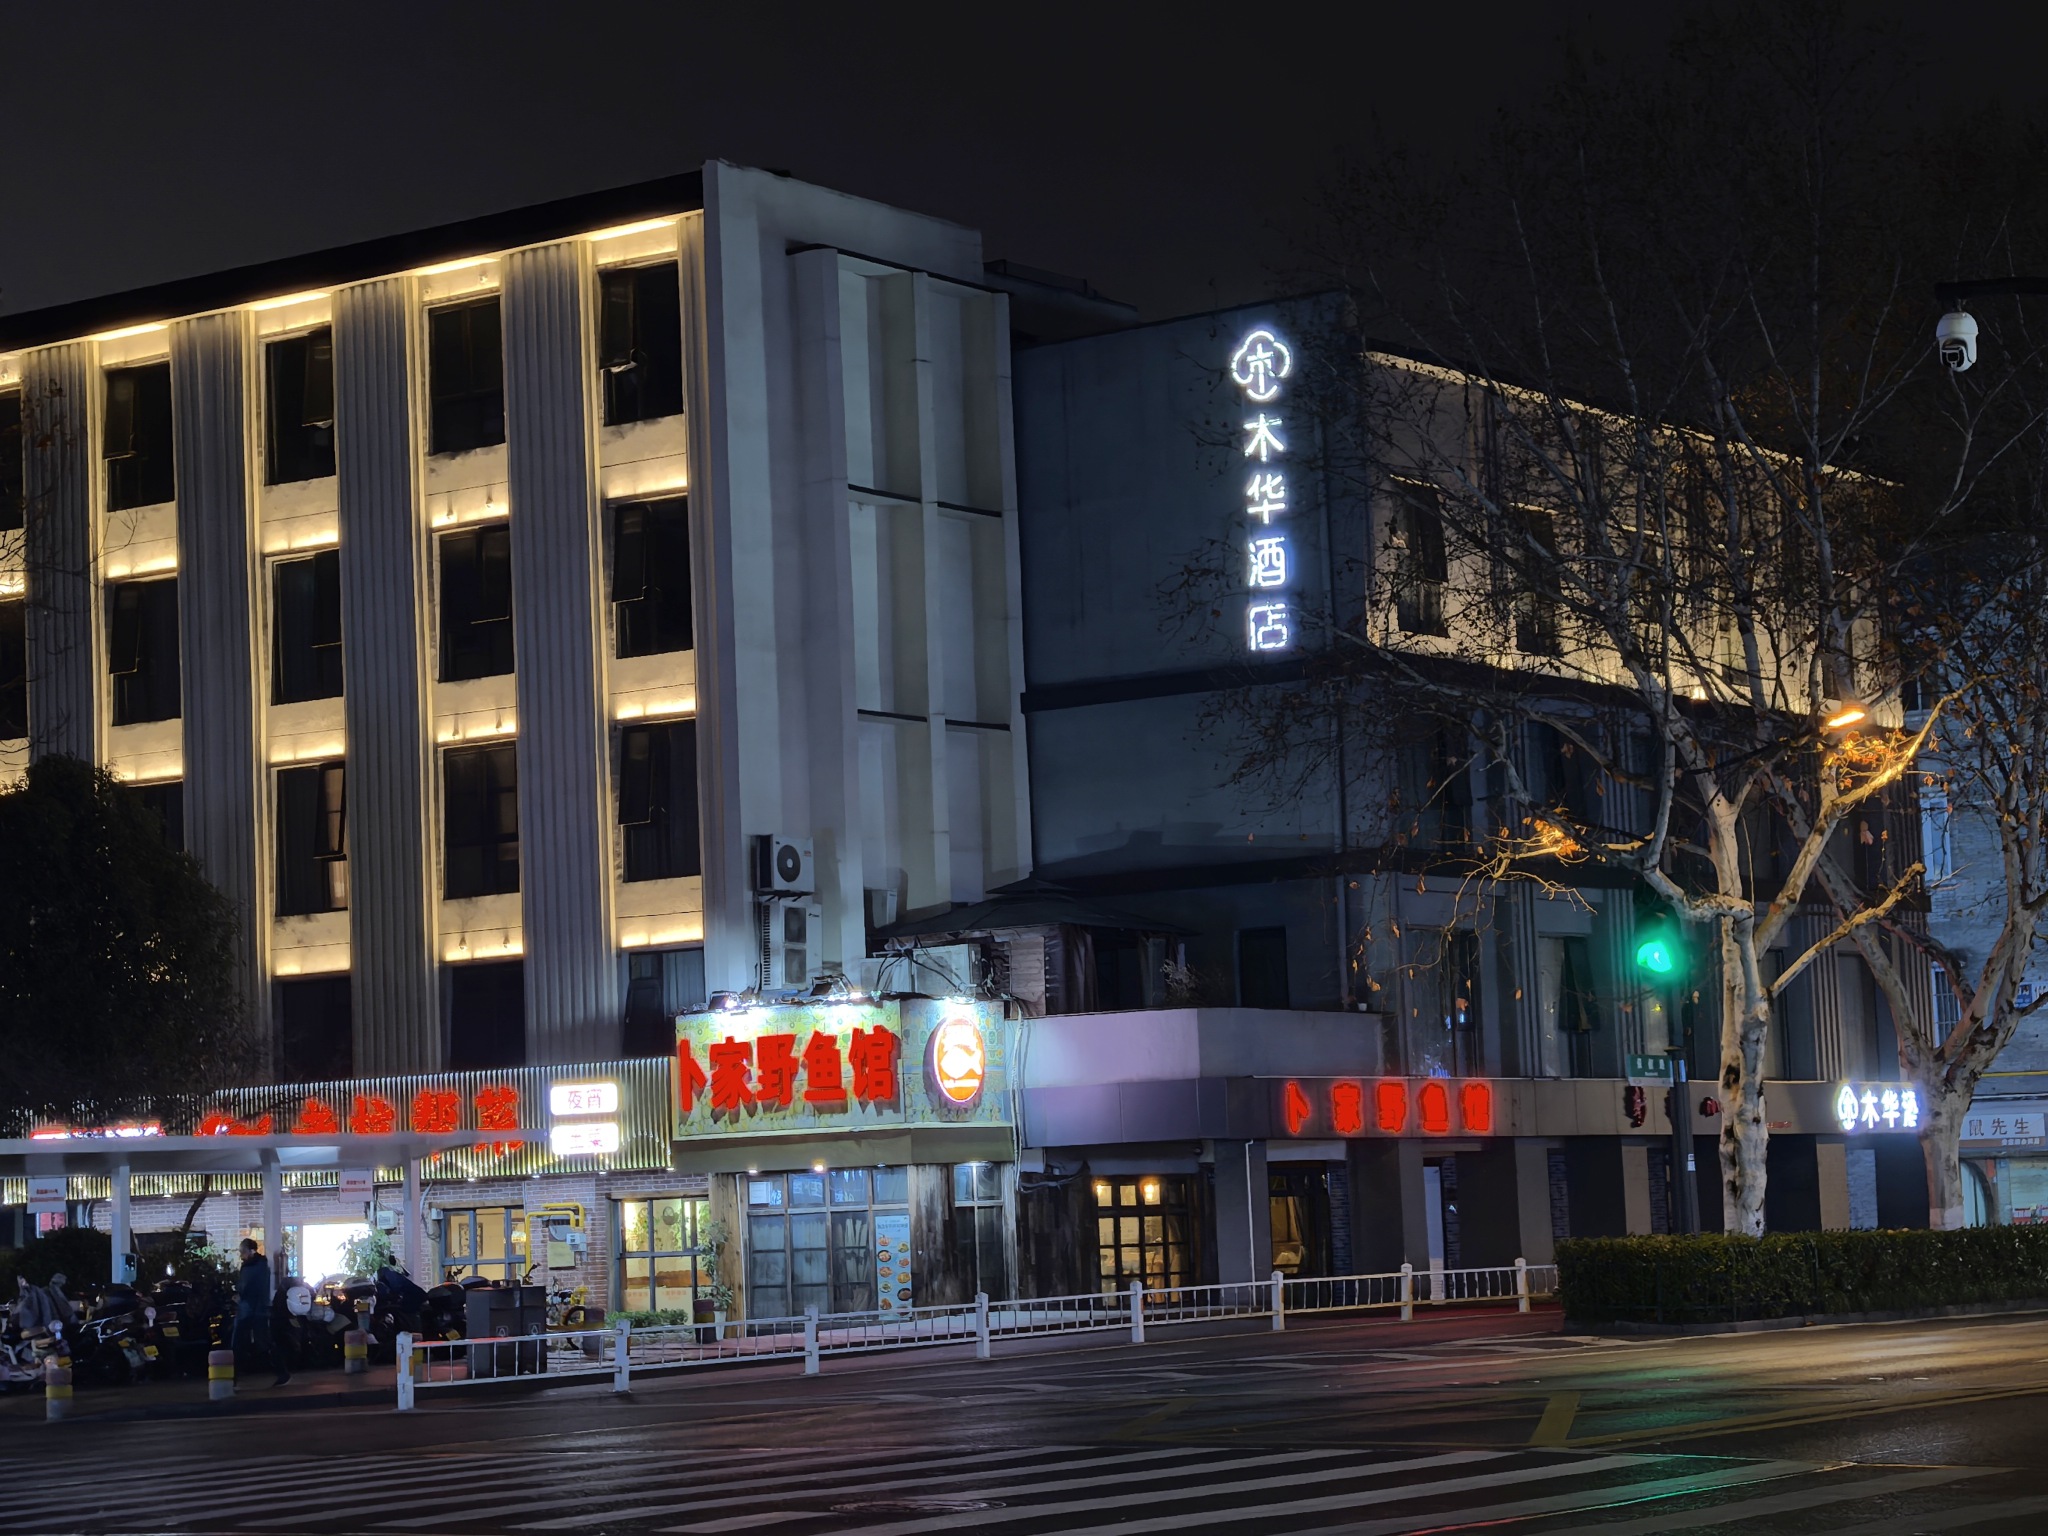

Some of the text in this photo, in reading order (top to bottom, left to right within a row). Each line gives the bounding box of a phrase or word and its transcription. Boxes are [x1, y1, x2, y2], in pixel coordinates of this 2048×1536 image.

[1244, 413, 1289, 651] 木华酒店
[567, 1088, 602, 1109] 夜宵
[677, 1026, 896, 1112] 卜家野鱼馆
